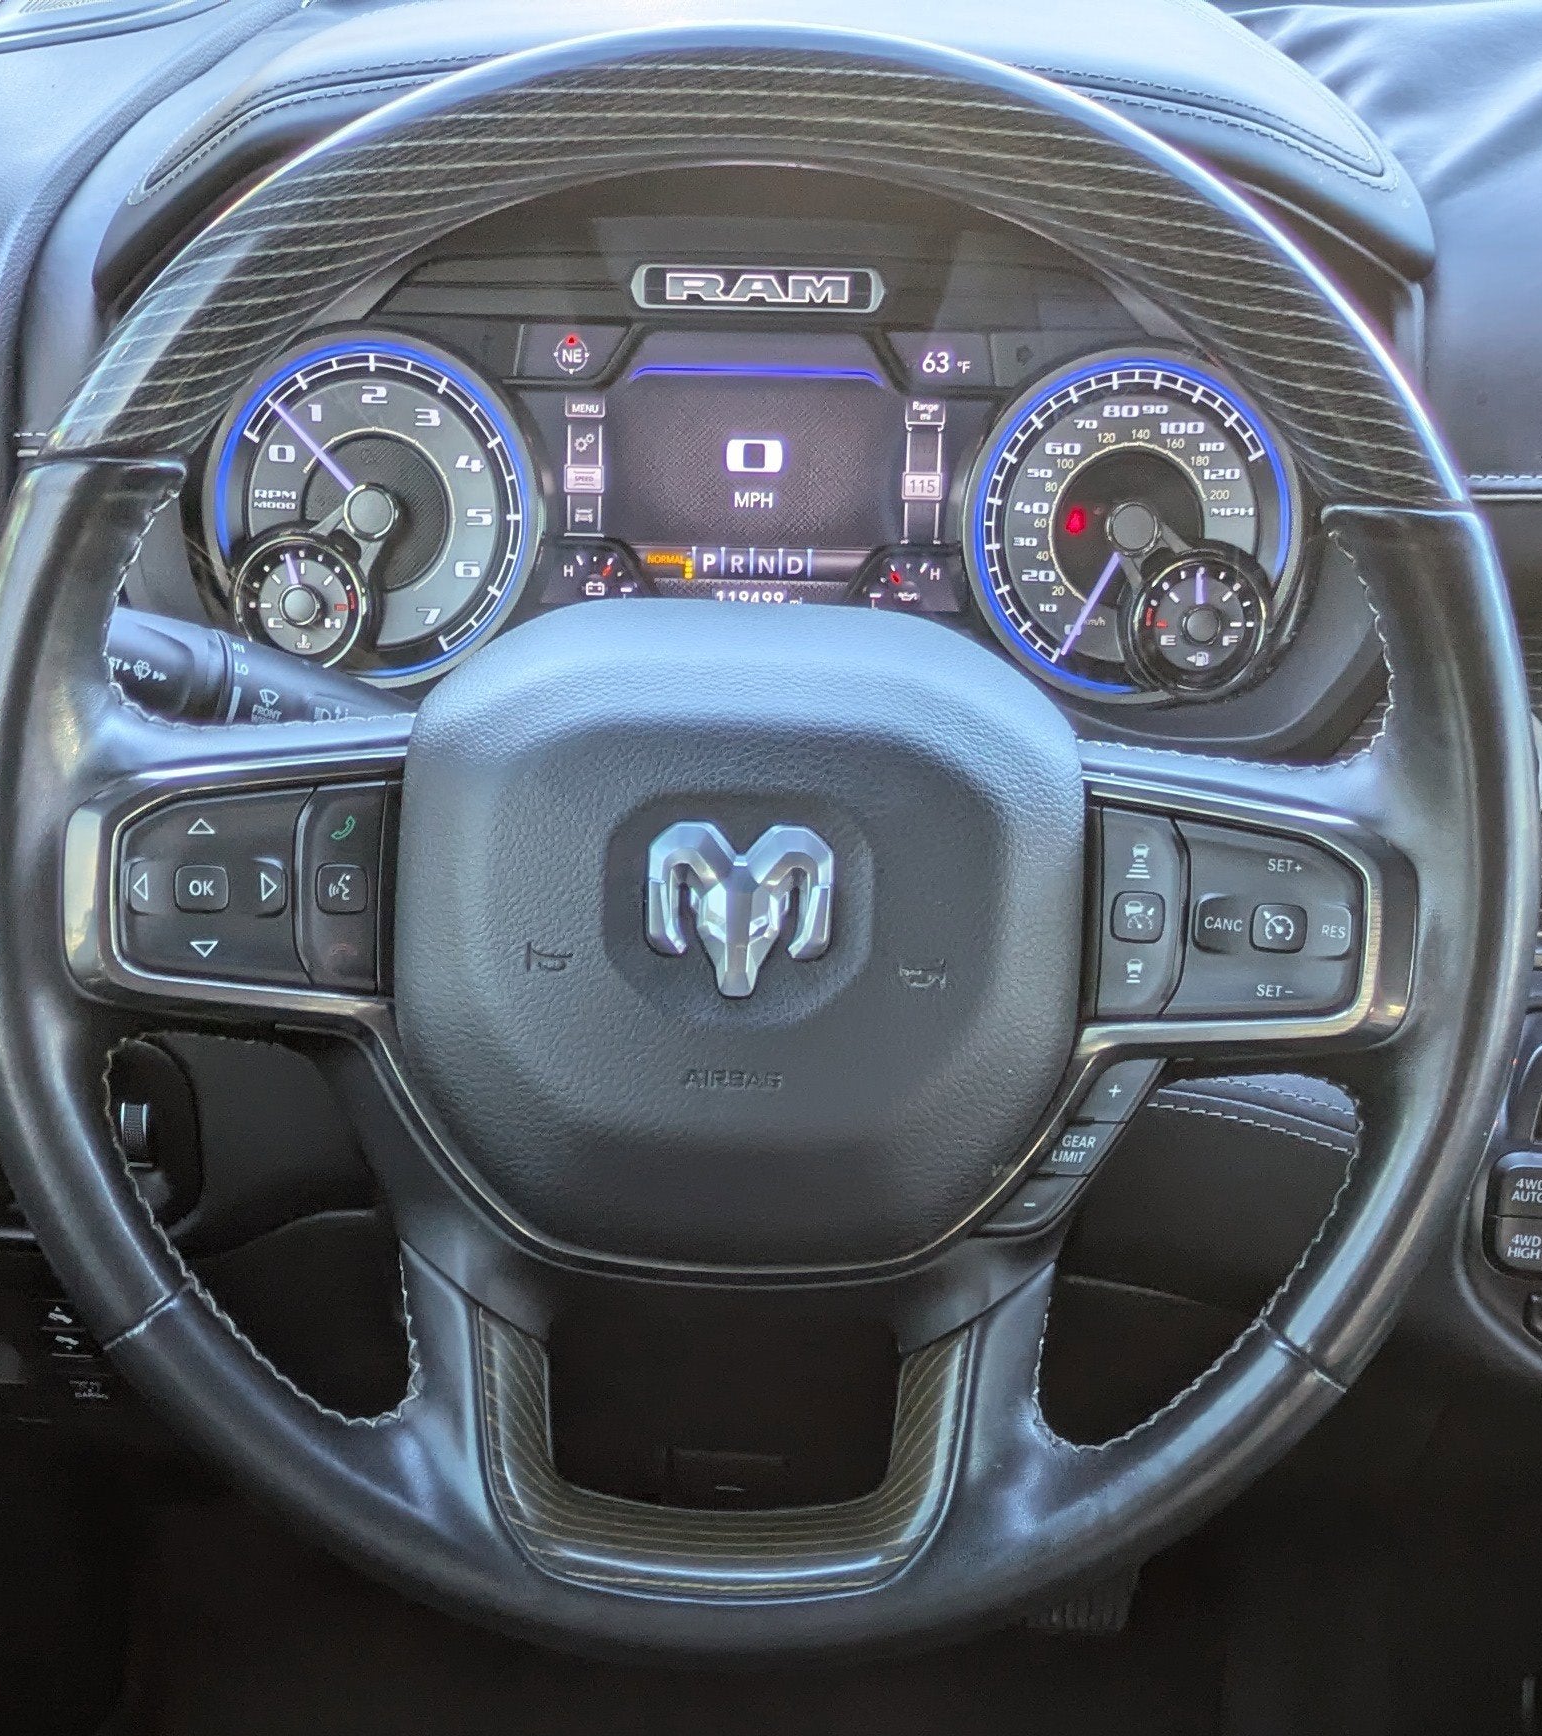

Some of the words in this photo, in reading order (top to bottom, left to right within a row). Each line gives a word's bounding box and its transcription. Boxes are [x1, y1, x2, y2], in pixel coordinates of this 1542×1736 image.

[666, 273, 850, 304] RAM
[562, 350, 582, 363] NE
[922, 352, 949, 373] 63
[361, 386, 388, 404] 2
[572, 404, 599, 413] MENU
[913, 401, 940, 412] Range
[1103, 405, 1139, 417] 80
[1142, 405, 1169, 415] 90
[308, 404, 322, 422] 1
[414, 408, 441, 427] 3
[1074, 420, 1098, 429] 70
[1160, 421, 1205, 434] 100
[1097, 433, 1116, 443] 120
[1131, 429, 1150, 440] 140
[1045, 443, 1081, 455] 60
[1166, 439, 1185, 448] 160
[1198, 442, 1225, 452] 110
[268, 445, 295, 462] 0
[726, 439, 783, 473] 0
[455, 455, 484, 473] 4
[1056, 459, 1074, 468] 100
[1191, 456, 1210, 466] 180
[1027, 469, 1053, 478] 50
[1203, 468, 1241, 480] 120
[910, 479, 936, 493] 115
[1045, 482, 1057, 492] 80
[254, 490, 296, 499] RPM
[1210, 490, 1230, 500] 200
[734, 493, 774, 509] MPH
[1014, 502, 1049, 514] 40
[1210, 508, 1254, 516] MPH
[466, 508, 492, 525] 5
[1034, 519, 1046, 528] 60
[1013, 537, 1038, 546] 30
[646, 554, 685, 564] NORMAL
[1036, 551, 1049, 561] 40
[455, 561, 481, 578] 6
[702, 553, 716, 573] P
[730, 555, 744, 572] R
[759, 556, 774, 574] N
[787, 557, 803, 574] D
[1021, 570, 1056, 582] 20
[1051, 586, 1065, 596] 20
[1039, 603, 1057, 612] 10
[417, 607, 442, 625] 7
[1161, 635, 1176, 645] E
[1222, 635, 1239, 646] F
[234, 662, 249, 675] LO
[189, 880, 215, 896] OK
[1204, 917, 1243, 932] CANC
[1321, 924, 1347, 939] RES
[684, 1068, 785, 1091] AIRBAG
[1061, 1135, 1097, 1149] GEAR
[1051, 1150, 1087, 1164] LIMIT
[1511, 1235, 1542, 1248] 4WD
[1507, 1247, 1542, 1260] HIGH
